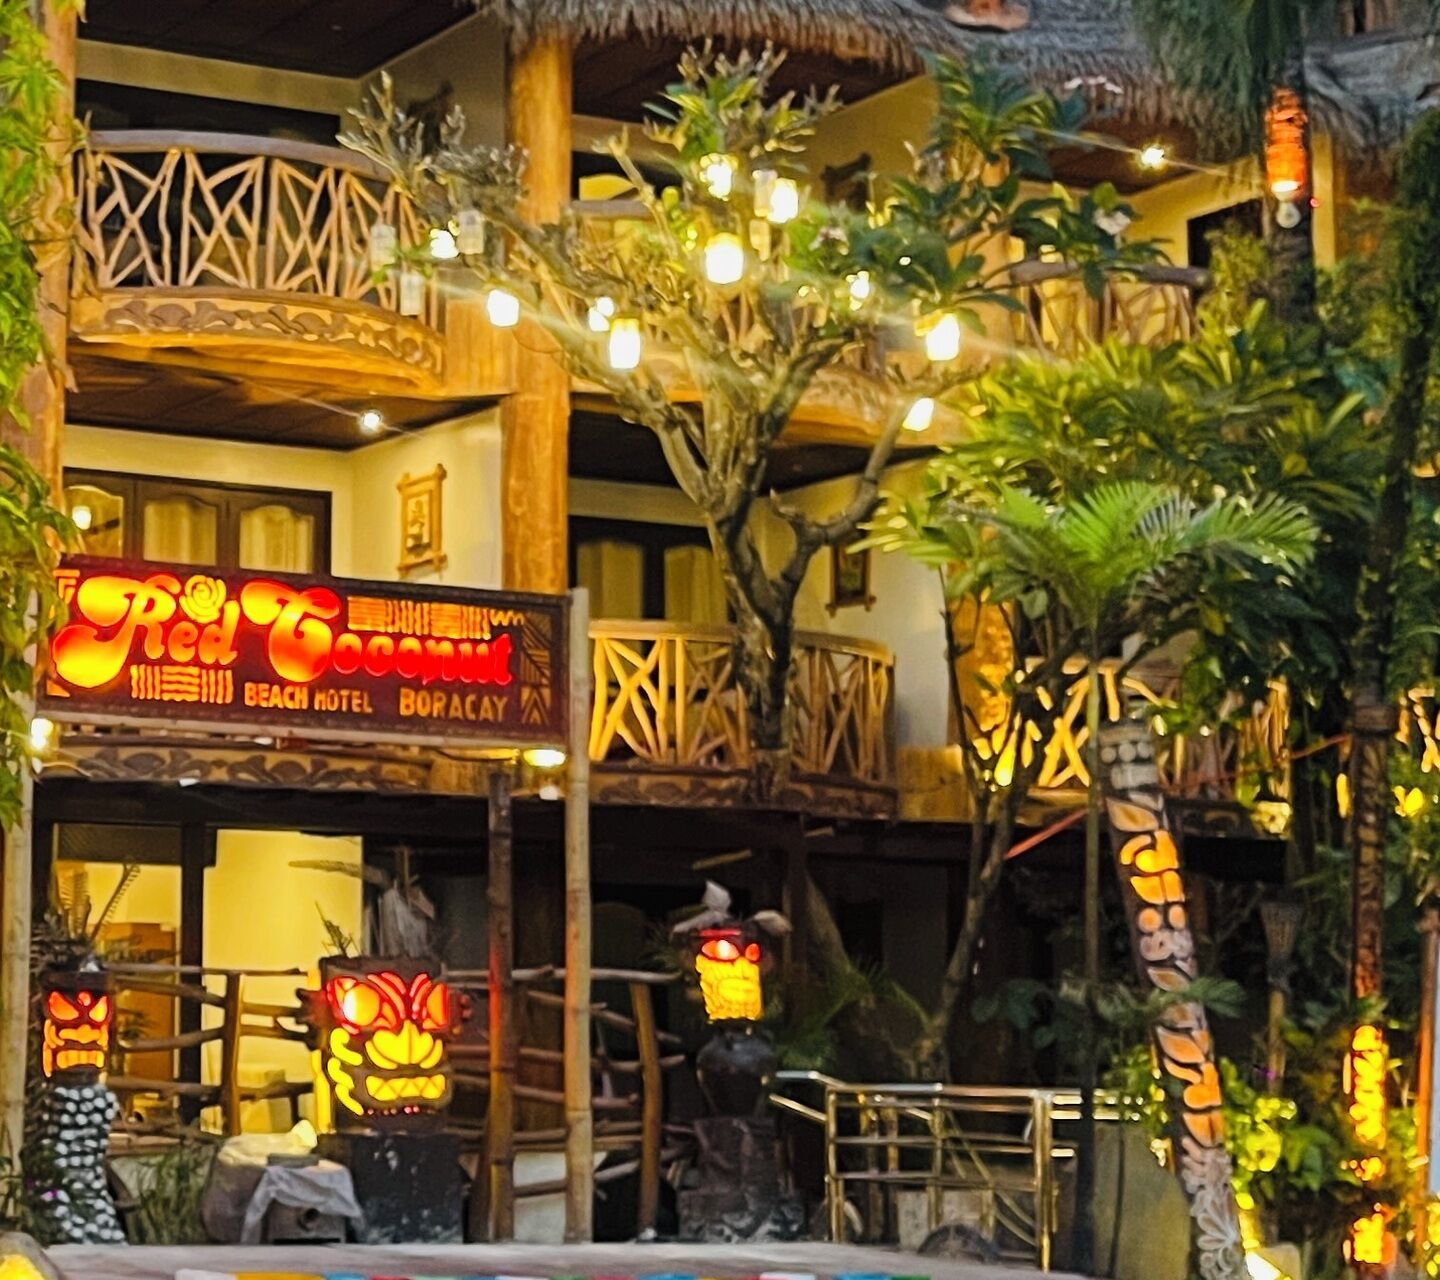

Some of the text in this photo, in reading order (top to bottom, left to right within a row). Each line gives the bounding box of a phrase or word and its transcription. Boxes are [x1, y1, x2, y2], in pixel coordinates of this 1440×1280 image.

[51, 573, 513, 689] Red Coconut
[244, 681, 508, 721] BEACH HOTEL BORACAY
